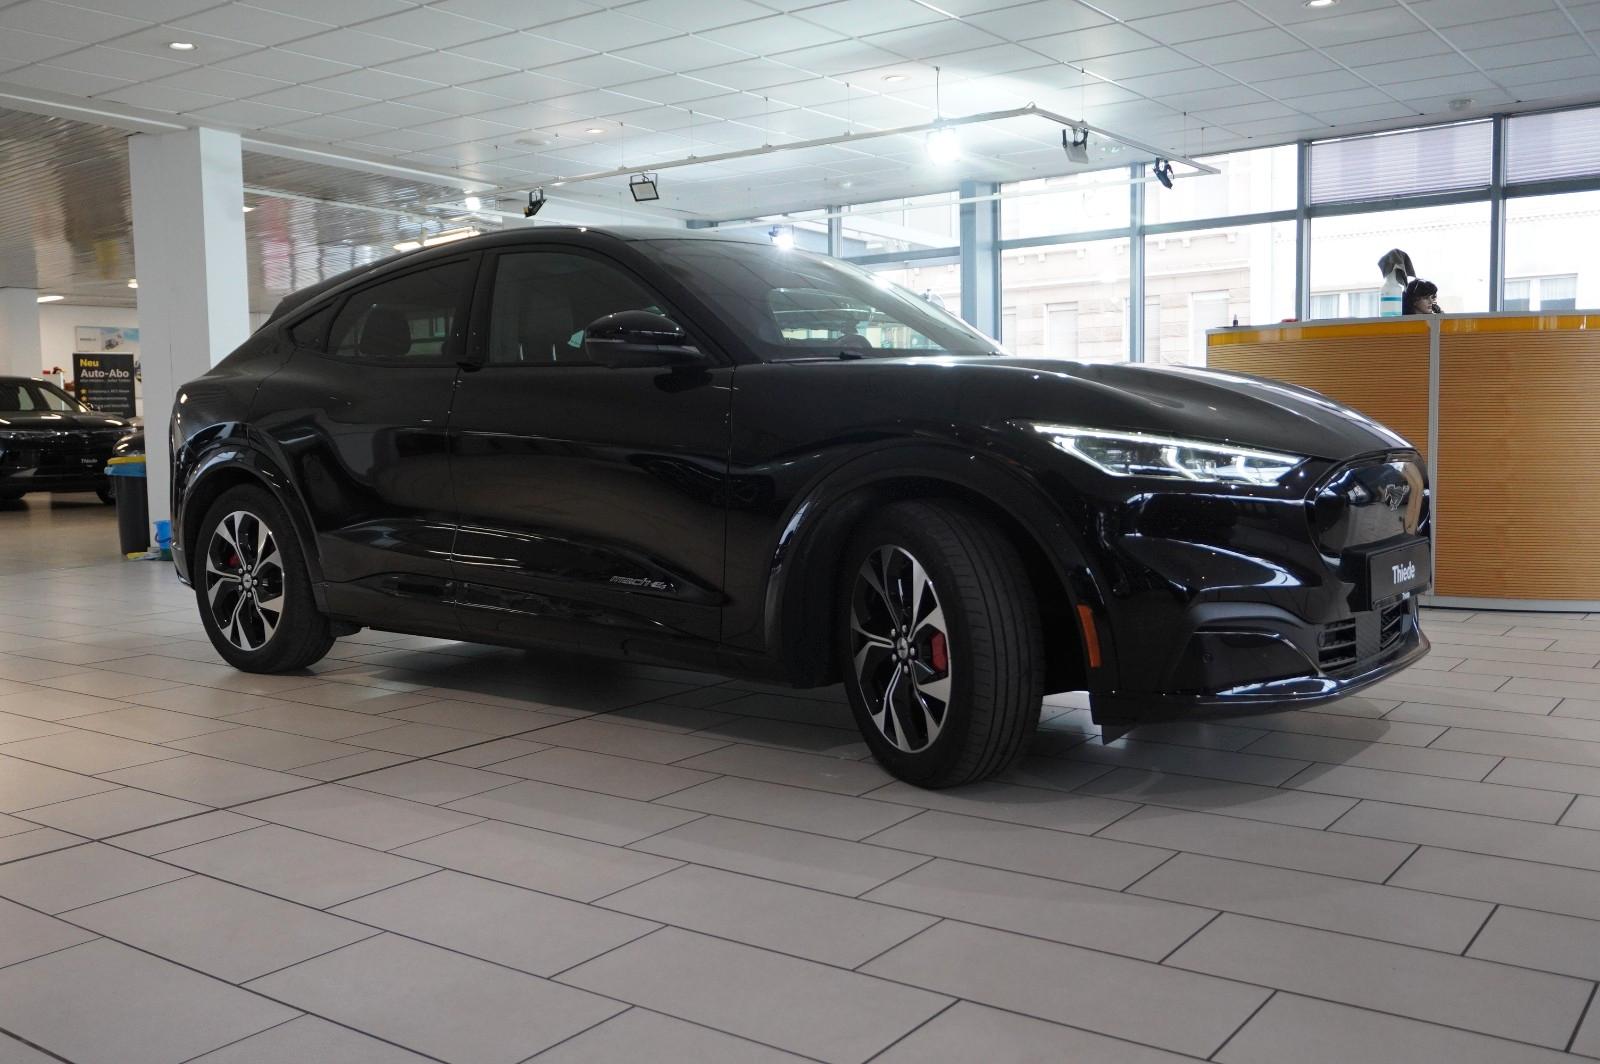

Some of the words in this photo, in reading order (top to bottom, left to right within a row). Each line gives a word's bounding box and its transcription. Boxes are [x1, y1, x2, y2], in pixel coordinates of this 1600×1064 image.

[80, 359, 99, 367] Neu
[80, 369, 130, 378] Auto-Abo
[1391, 560, 1416, 584] Thiede
